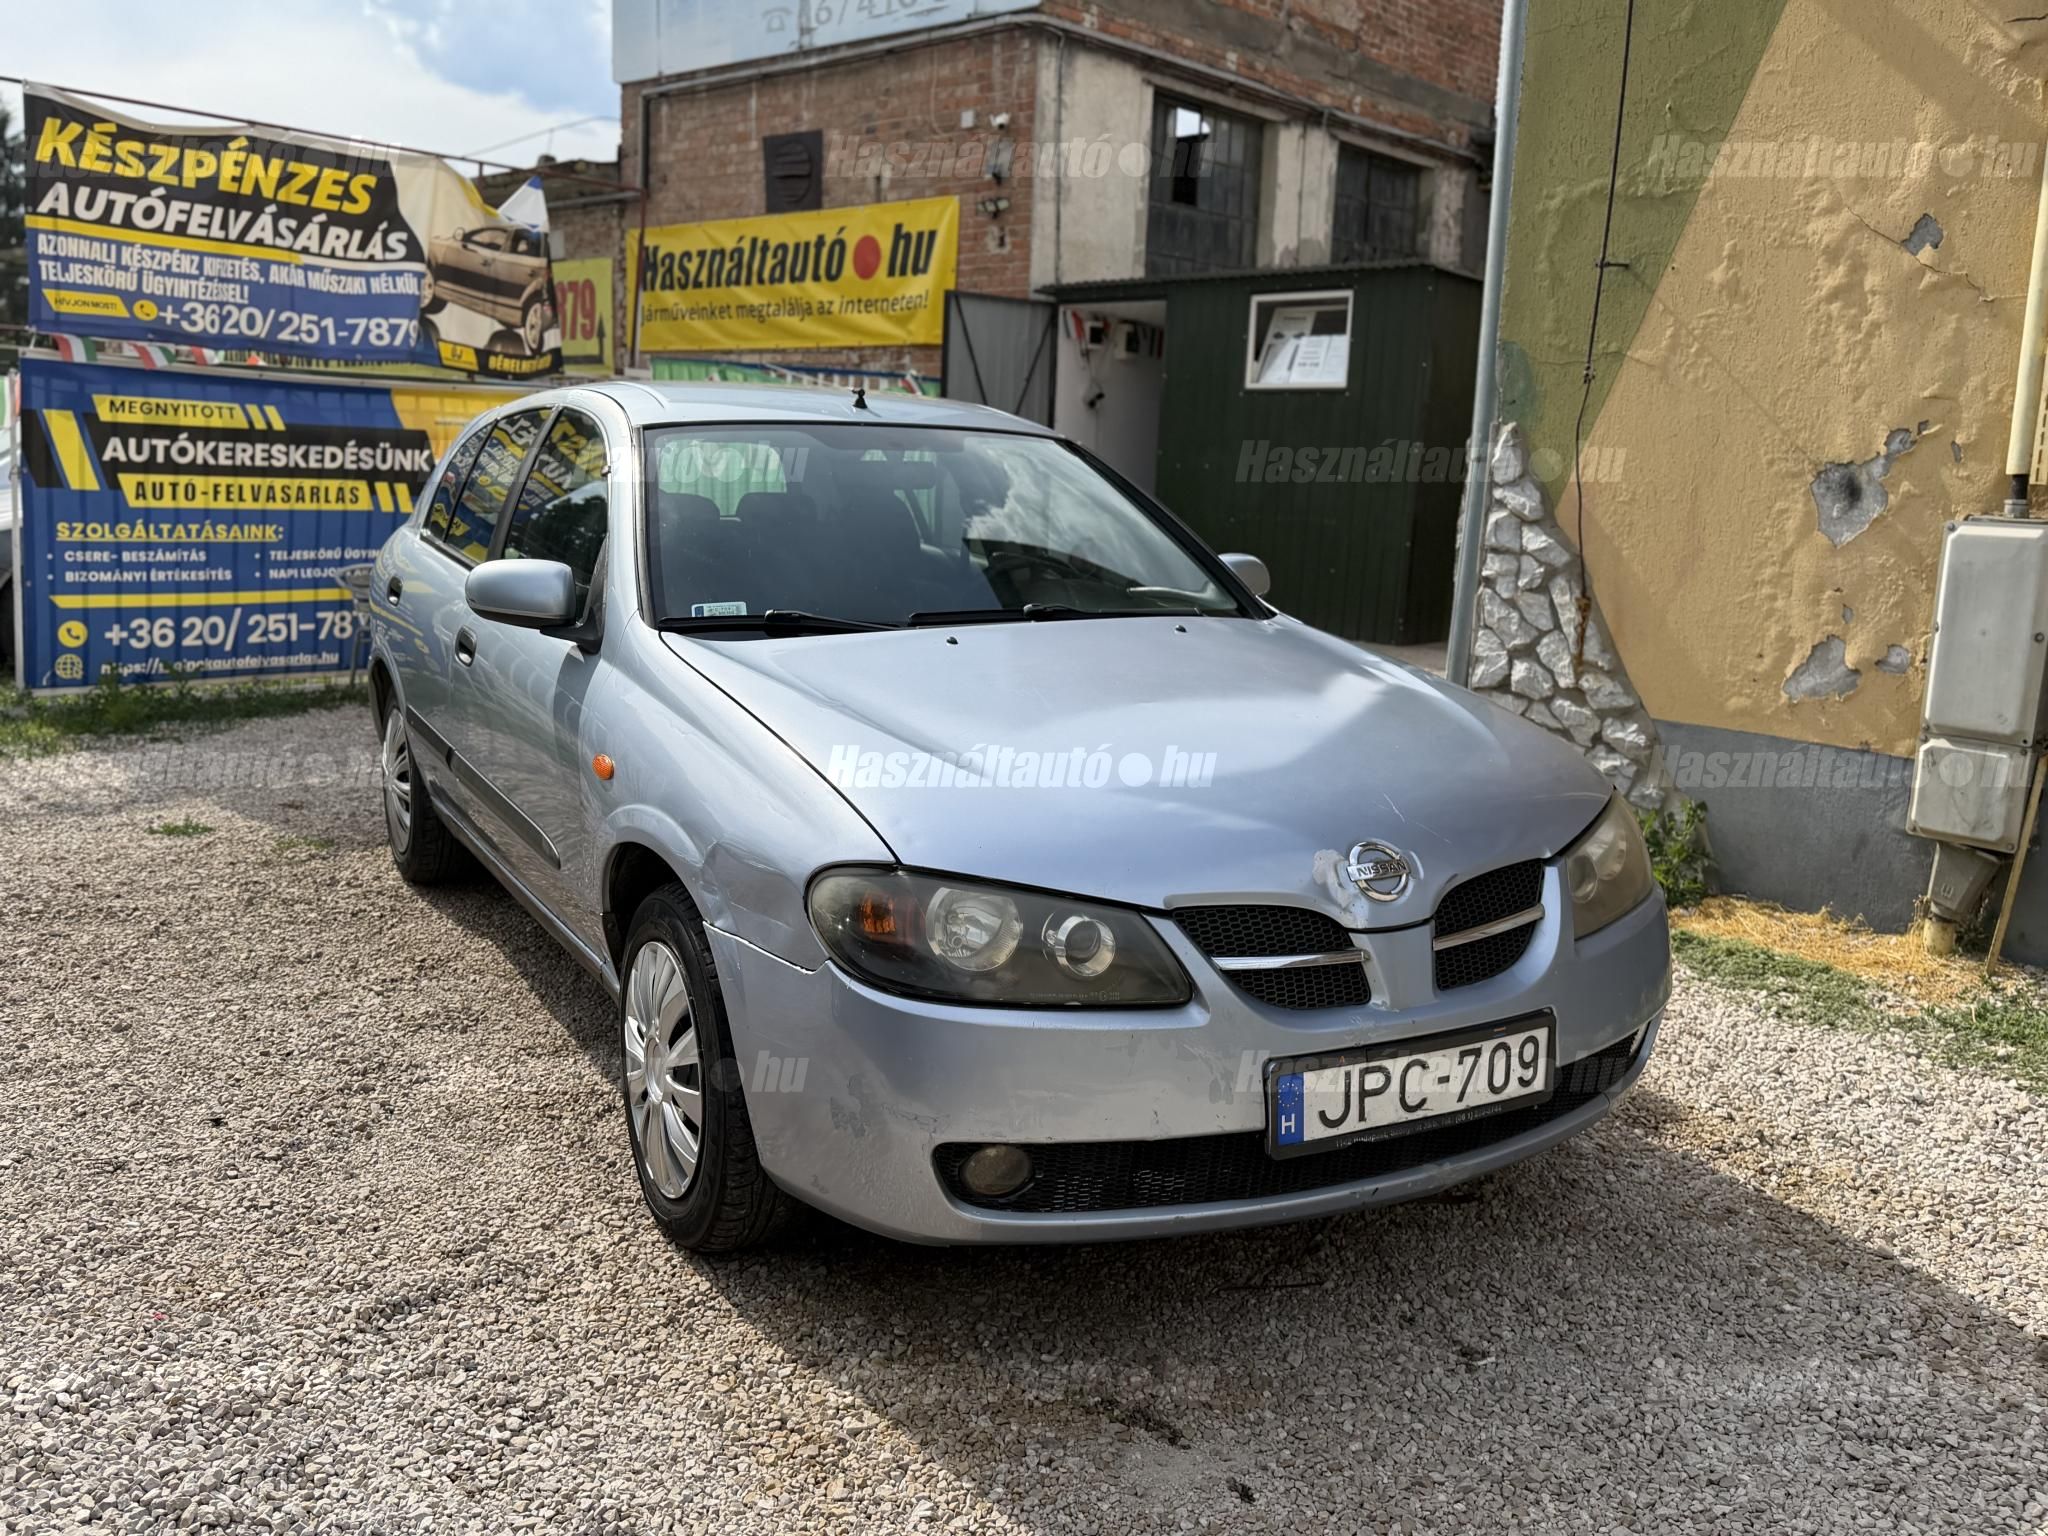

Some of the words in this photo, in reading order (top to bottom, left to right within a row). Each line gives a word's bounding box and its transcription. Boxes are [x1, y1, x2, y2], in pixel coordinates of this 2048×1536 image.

[35, 117, 377, 214] KÉSZPÉNZES
[36, 182, 408, 260] AUTÓFELVÁSÁRLÁS
[38, 234, 116, 264] AZONNALI
[121, 244, 199, 274] KÉSZPÉNZ
[269, 263, 306, 288] AKÁR
[308, 268, 367, 294] MŰSZAKI
[371, 271, 420, 296] NÉLKÜL
[642, 226, 847, 292] Használtautó
[38, 260, 138, 292] TELJESKÖRŰ
[142, 270, 249, 305] ÜGYINTÉZÉSSEL!
[640, 301, 732, 326] Járműveinket
[736, 297, 814, 323] megtalálja
[816, 300, 834, 314] az
[838, 289, 929, 315] interneten!
[109, 399, 237, 420] MEGNYITOTT
[102, 432, 431, 472] AUTÓKERESKEDÉSÜNK
[135, 478, 360, 504] AUTÓ-FELVÁSÁRLÁS
[56, 519, 284, 541] SZOLGÁLTATÁSAINK:
[122, 548, 207, 562] BESZÁMÍTÁS
[269, 547, 342, 560] TELJESKÖRŰ
[65, 569, 147, 582] BIZOMÁNYI
[150, 567, 232, 581] ÉRTÉKESÍTÉS
[269, 568, 298, 579] NAPI
[104, 617, 175, 649] +36
[1357, 861, 1407, 878] NISSAN
[1319, 1035, 1539, 1129] JPC-709
[1281, 1114, 1295, 1135] H
